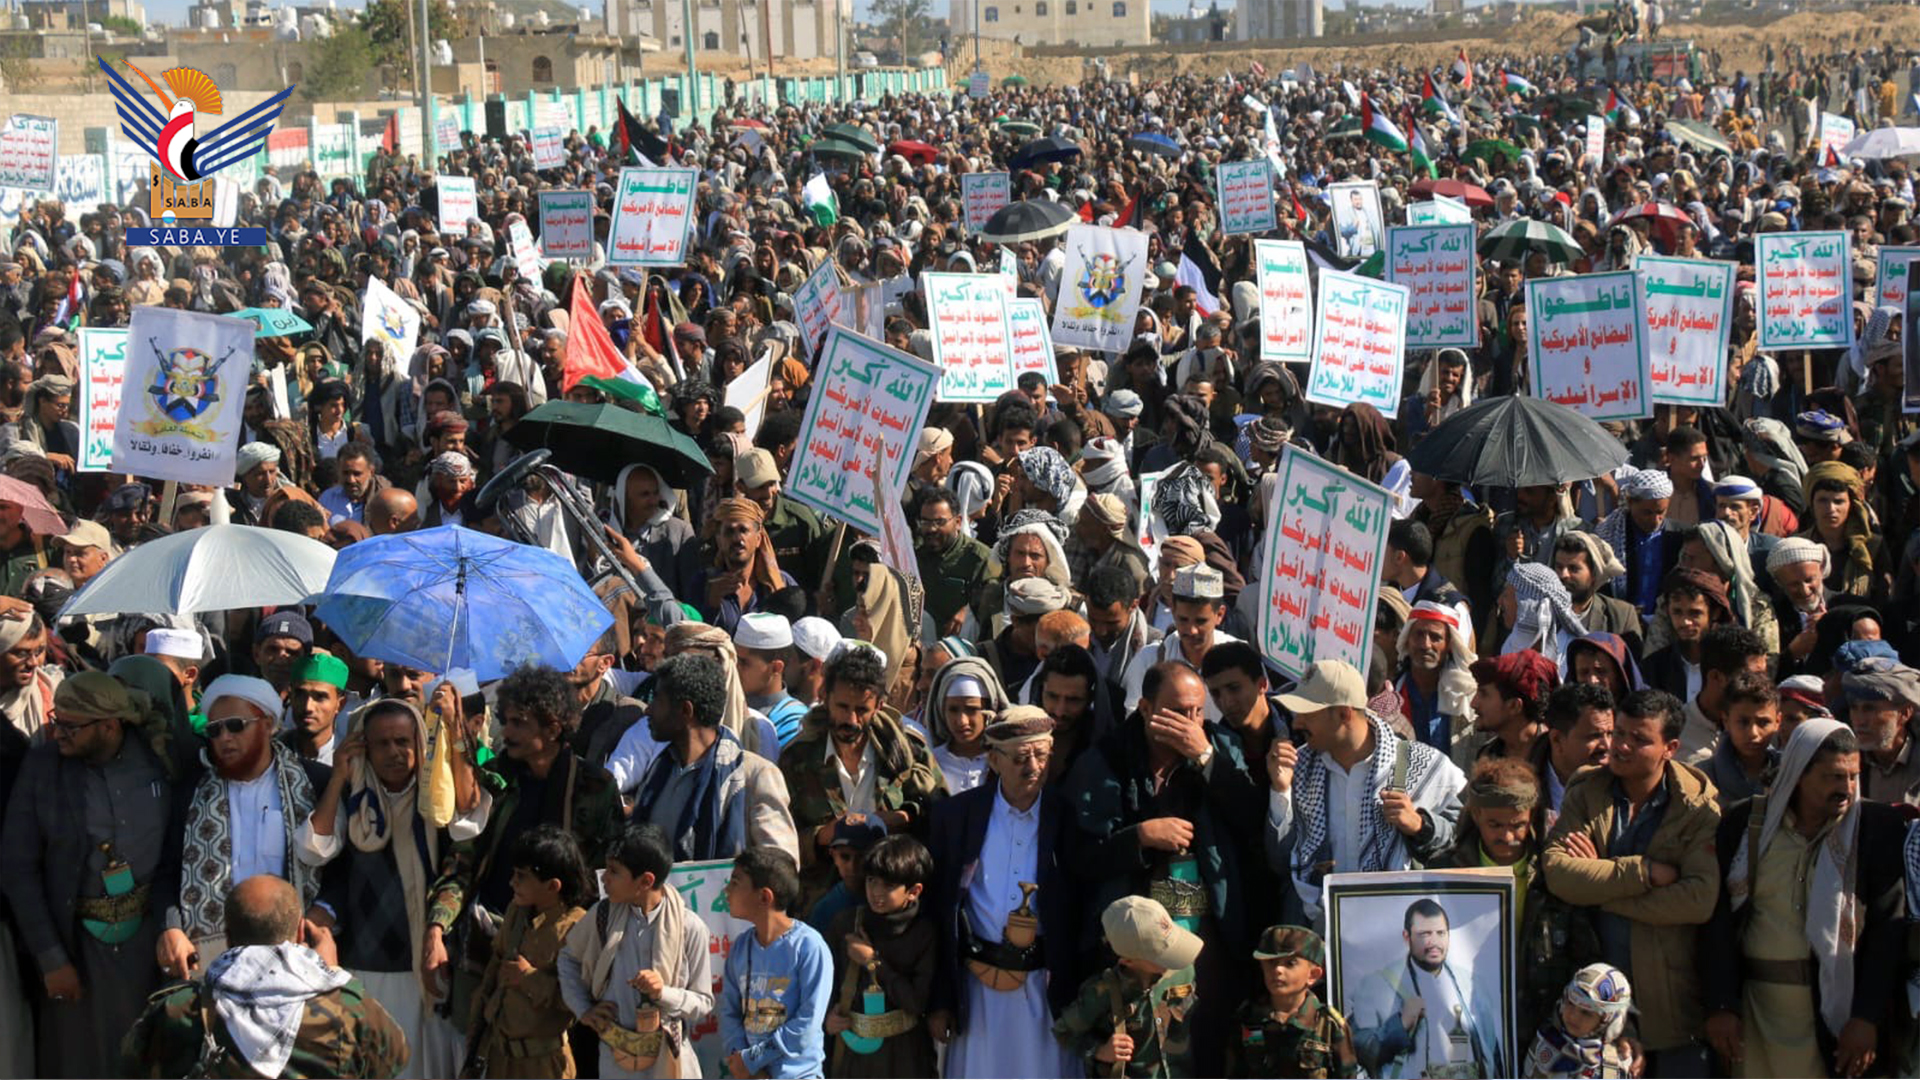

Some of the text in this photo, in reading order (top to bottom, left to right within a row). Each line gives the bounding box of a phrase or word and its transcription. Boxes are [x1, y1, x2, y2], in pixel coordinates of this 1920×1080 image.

[1395, 231, 1468, 259] الله أكبر
[1767, 240, 1840, 265] الله أكبر
[1328, 289, 1398, 314] الله أكبر
[1538, 284, 1631, 322] قاطعوا
[1646, 273, 1722, 298] قاطعو
[1591, 323, 1633, 350] البضائع
[832, 357, 924, 404] الله أكبر
[871, 404, 912, 434] الموت
[800, 461, 846, 501] للإسلام
[1287, 479, 1380, 536] الله أكبر
[1281, 512, 1373, 574] الموت لأمريكا
[1276, 552, 1368, 612] الموت لإسرائيل
[1272, 588, 1363, 647] اللعنة على اليهود
[1270, 621, 1317, 670] للإسلام
